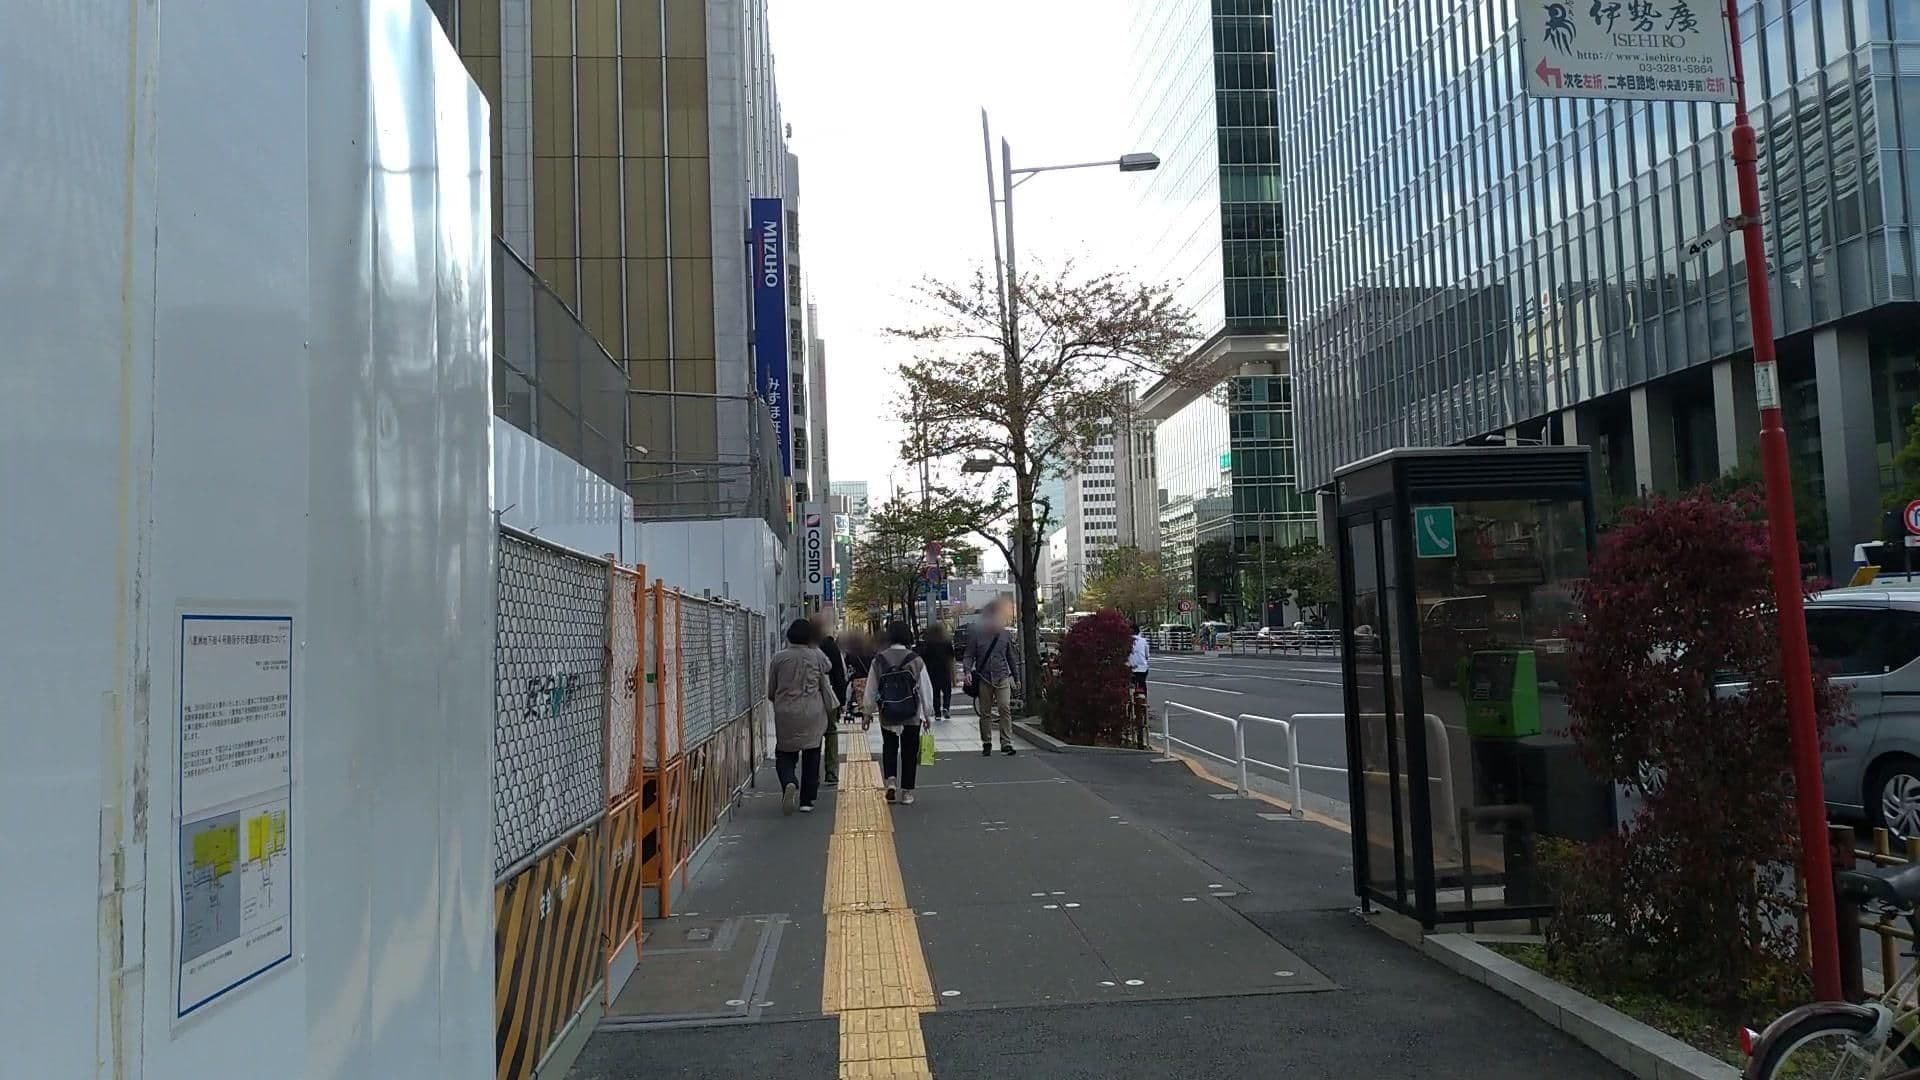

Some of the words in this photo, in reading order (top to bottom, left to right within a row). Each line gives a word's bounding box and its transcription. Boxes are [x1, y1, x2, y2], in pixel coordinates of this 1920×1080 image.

[1612, 33, 1686, 48] ISEHIRO
[1639, 64, 1713, 74] 03-3281-5864
[763, 221, 778, 288] MIZUHO
[807, 529, 821, 584] COSMO
